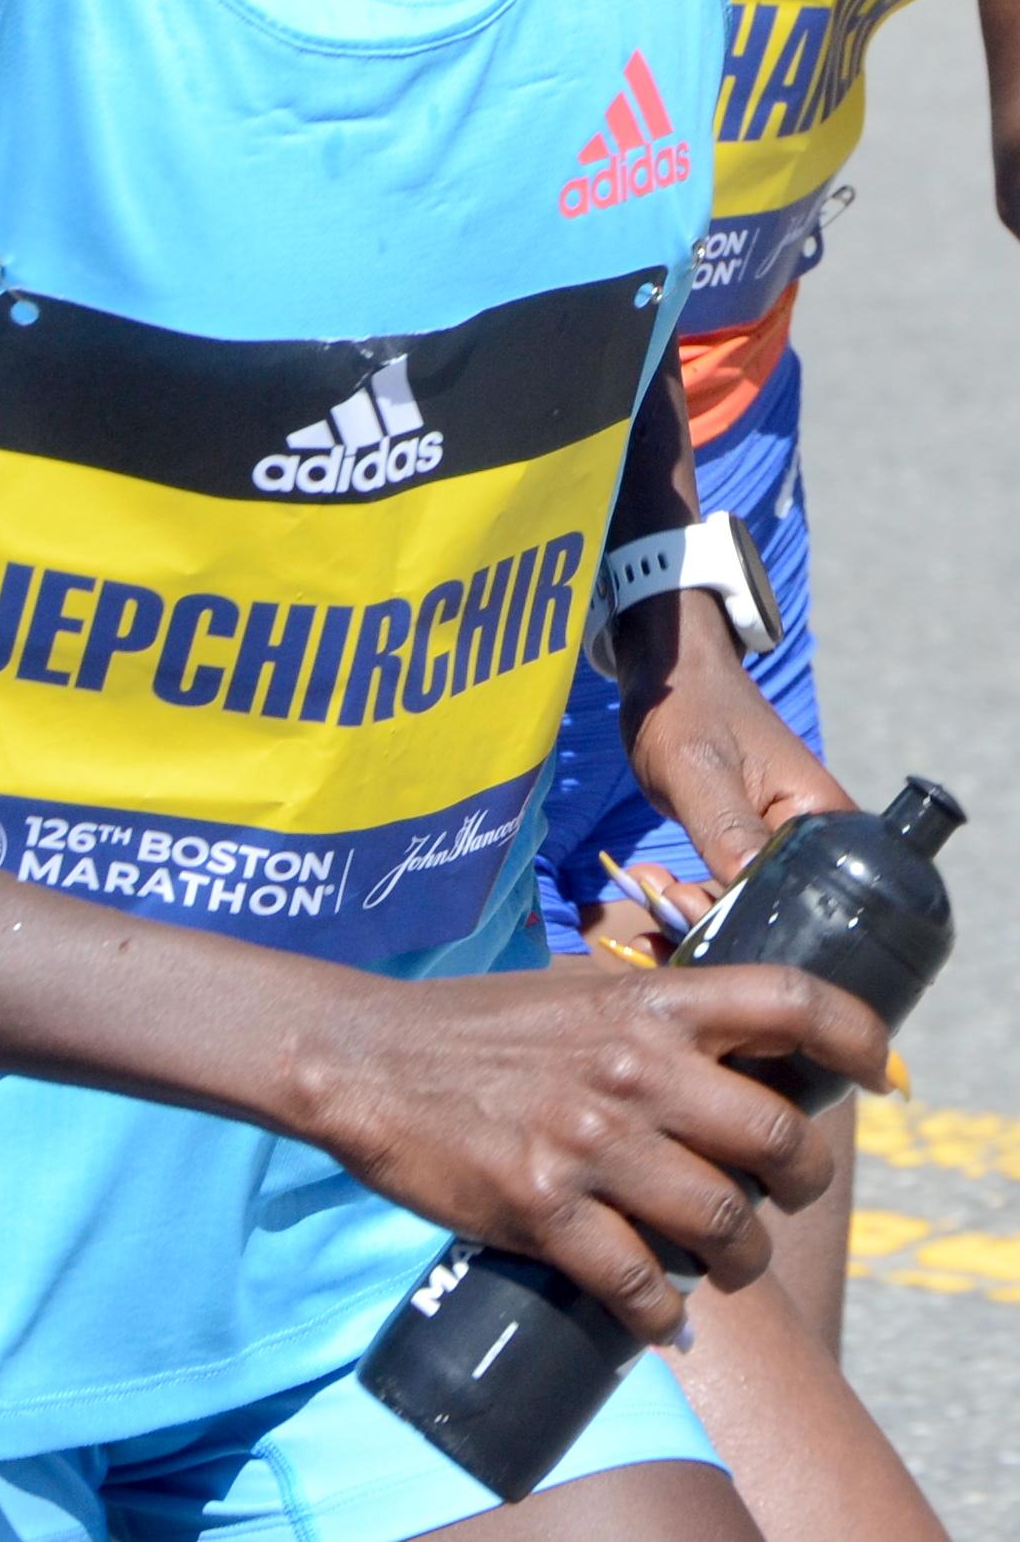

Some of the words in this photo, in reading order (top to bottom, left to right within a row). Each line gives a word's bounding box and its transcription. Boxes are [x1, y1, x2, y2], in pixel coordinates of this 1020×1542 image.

[559, 141, 691, 218] adidas
[702, 230, 748, 259] ON
[252, 431, 444, 494] adidas
[25, 816, 133, 853] 126TH
[137, 829, 335, 882] BOSTON
[17, 850, 324, 917] MARATHON
